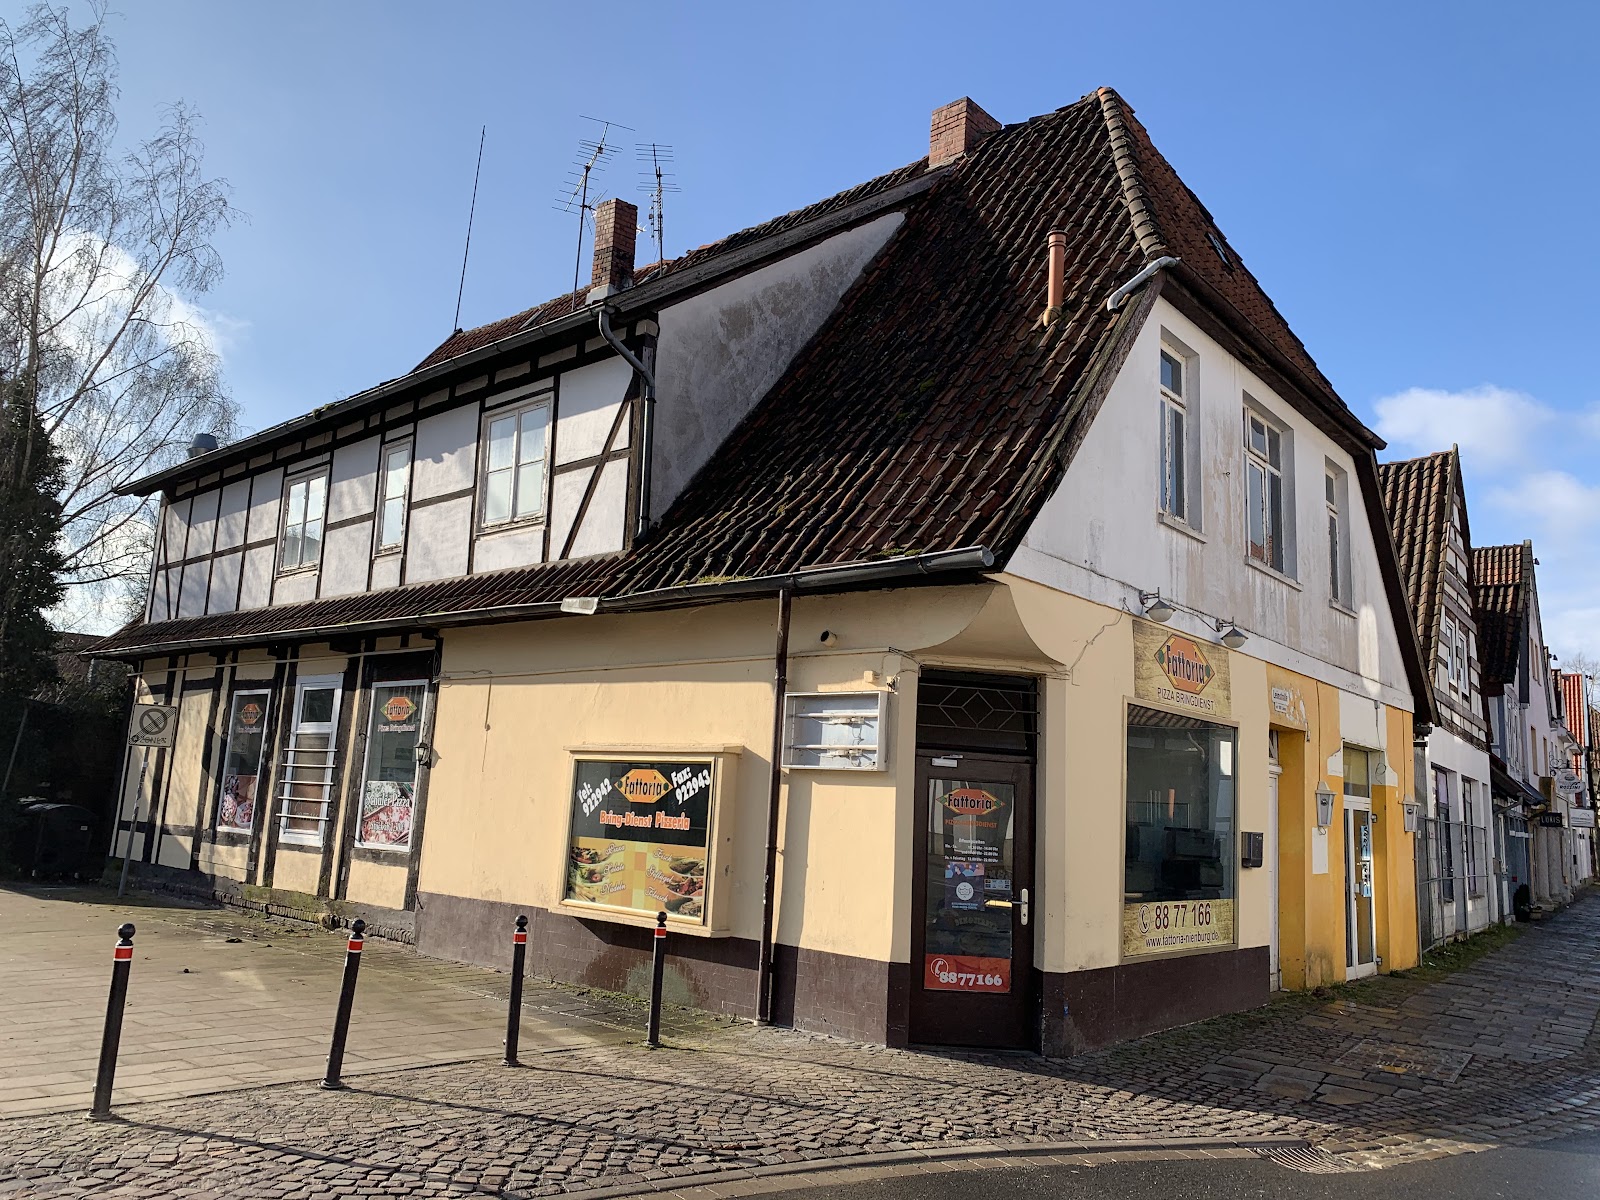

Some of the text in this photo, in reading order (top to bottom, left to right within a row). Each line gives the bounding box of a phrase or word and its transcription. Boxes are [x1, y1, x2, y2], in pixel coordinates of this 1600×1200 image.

[1166, 644, 1205, 685] Fattoria
[386, 701, 411, 716] Fattoria
[1157, 687, 1214, 711] PIZZA BRINGDIENST
[624, 775, 662, 797] Fattoria
[670, 766, 692, 789] Fax:
[675, 768, 711, 806] 922943
[389, 793, 411, 808] Pizza
[577, 781, 593, 804] Tel:
[582, 777, 613, 818] 922942
[947, 793, 993, 811] Fattoria
[599, 809, 691, 831] Bring-Dienst Pizzeria
[1155, 902, 1211, 930] 88 77 166
[1145, 929, 1219, 948] www.fattoria-nienburg.de
[939, 971, 1003, 987] 8877166
